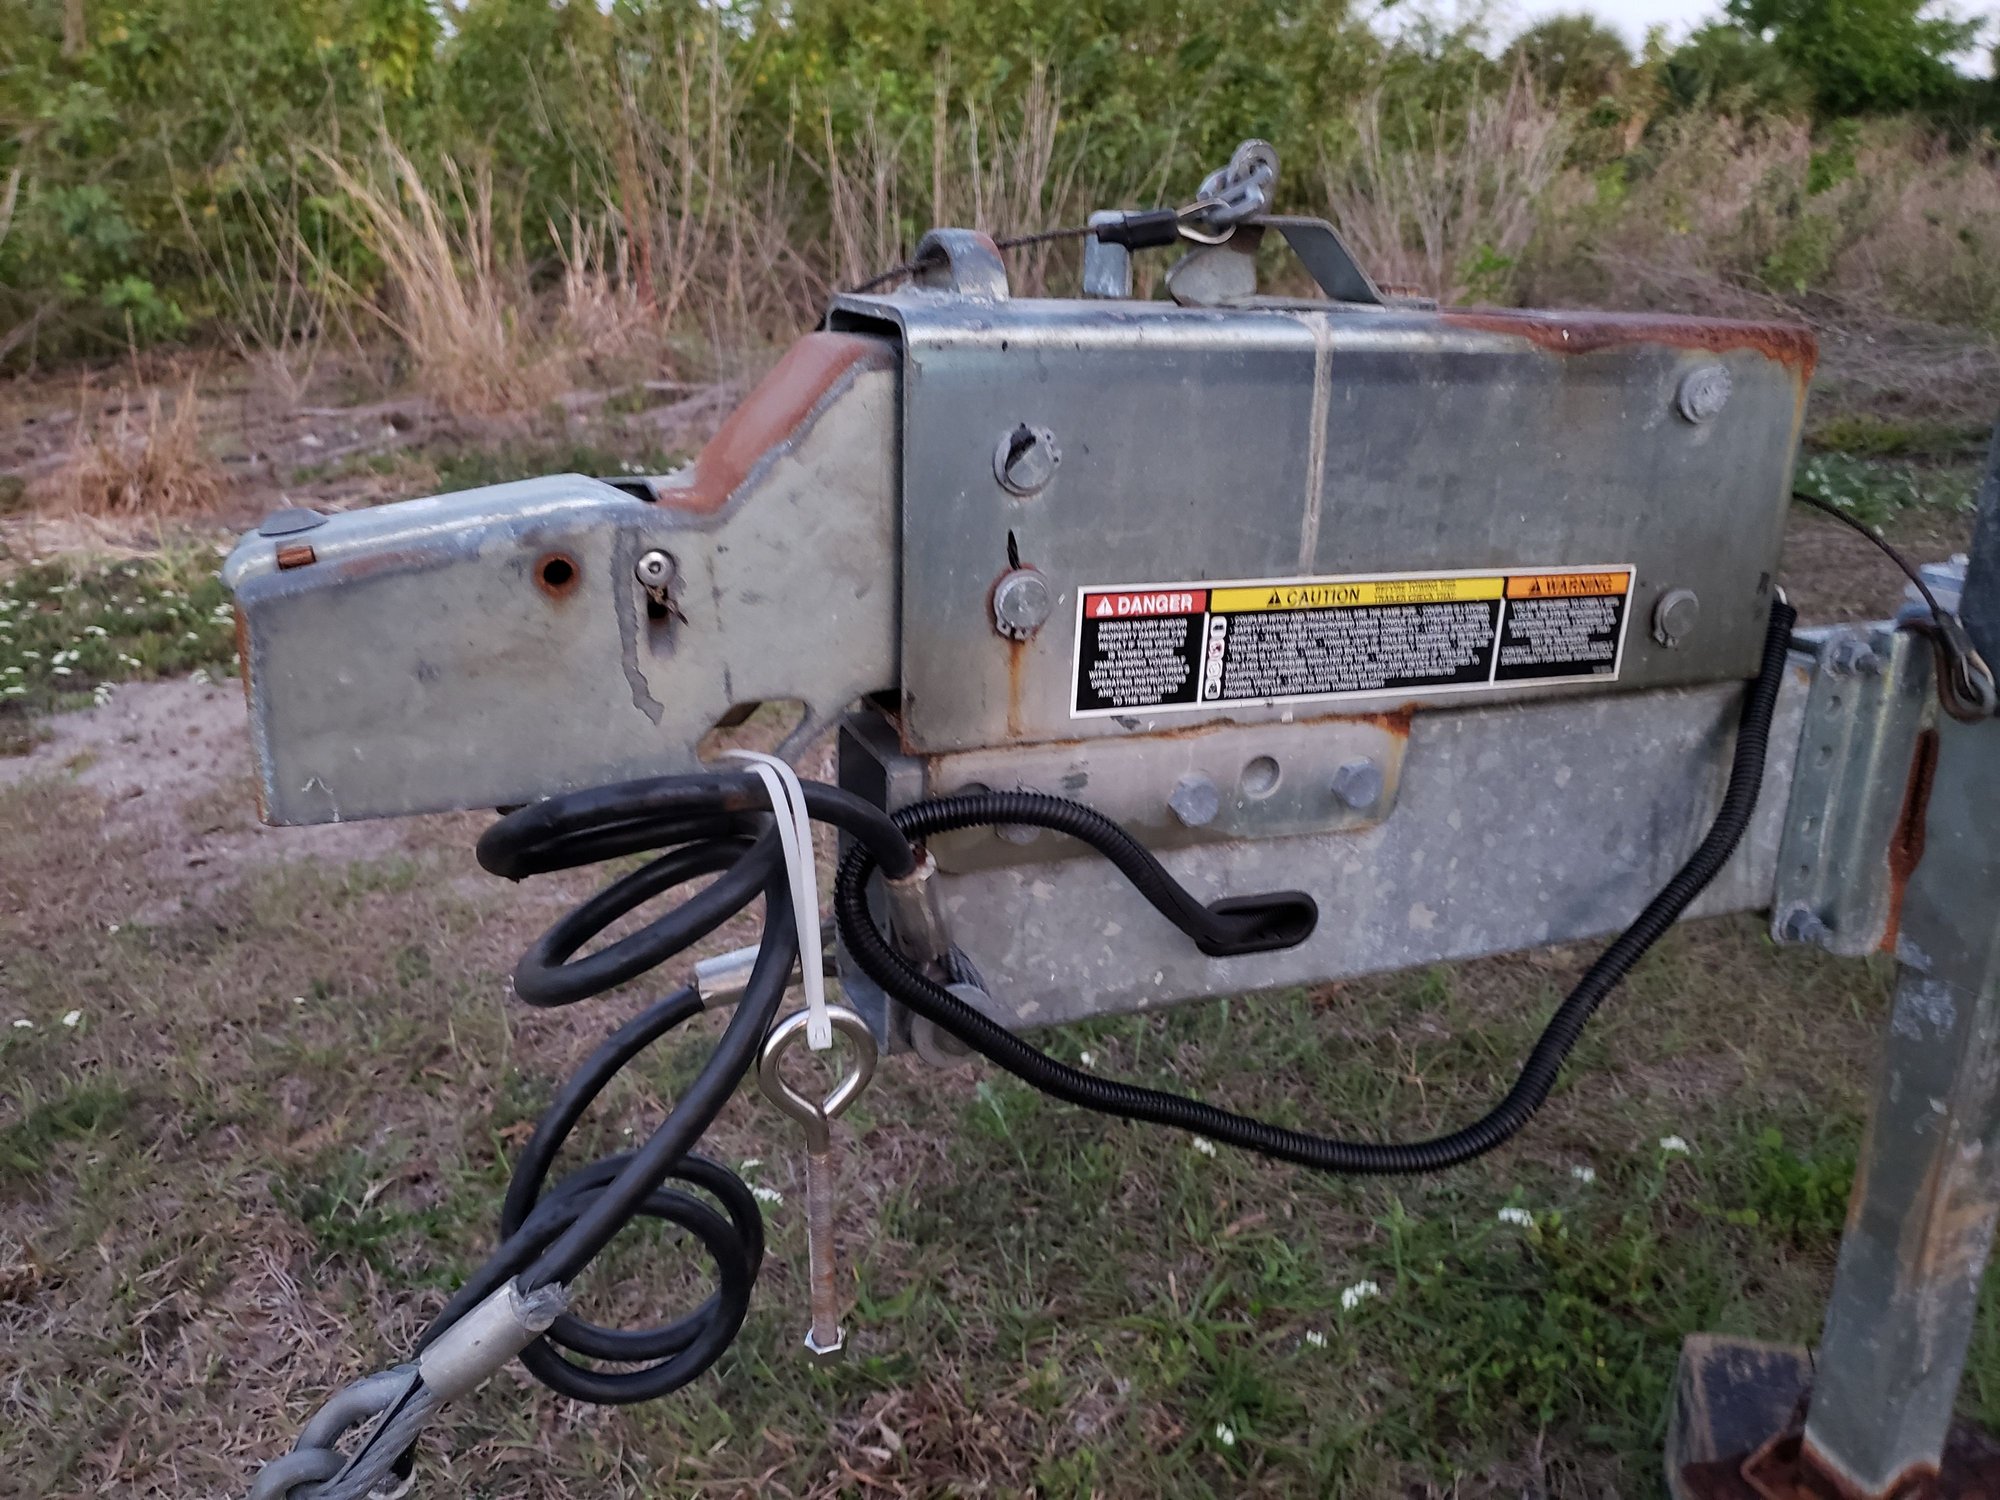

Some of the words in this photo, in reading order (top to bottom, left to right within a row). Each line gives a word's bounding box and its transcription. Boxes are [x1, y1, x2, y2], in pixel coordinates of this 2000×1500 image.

[1547, 575, 1612, 595] WARNING
[1118, 594, 1192, 614] DANGER
[1286, 587, 1360, 606] CAUTION
[1375, 593, 1406, 603] TRAILER
